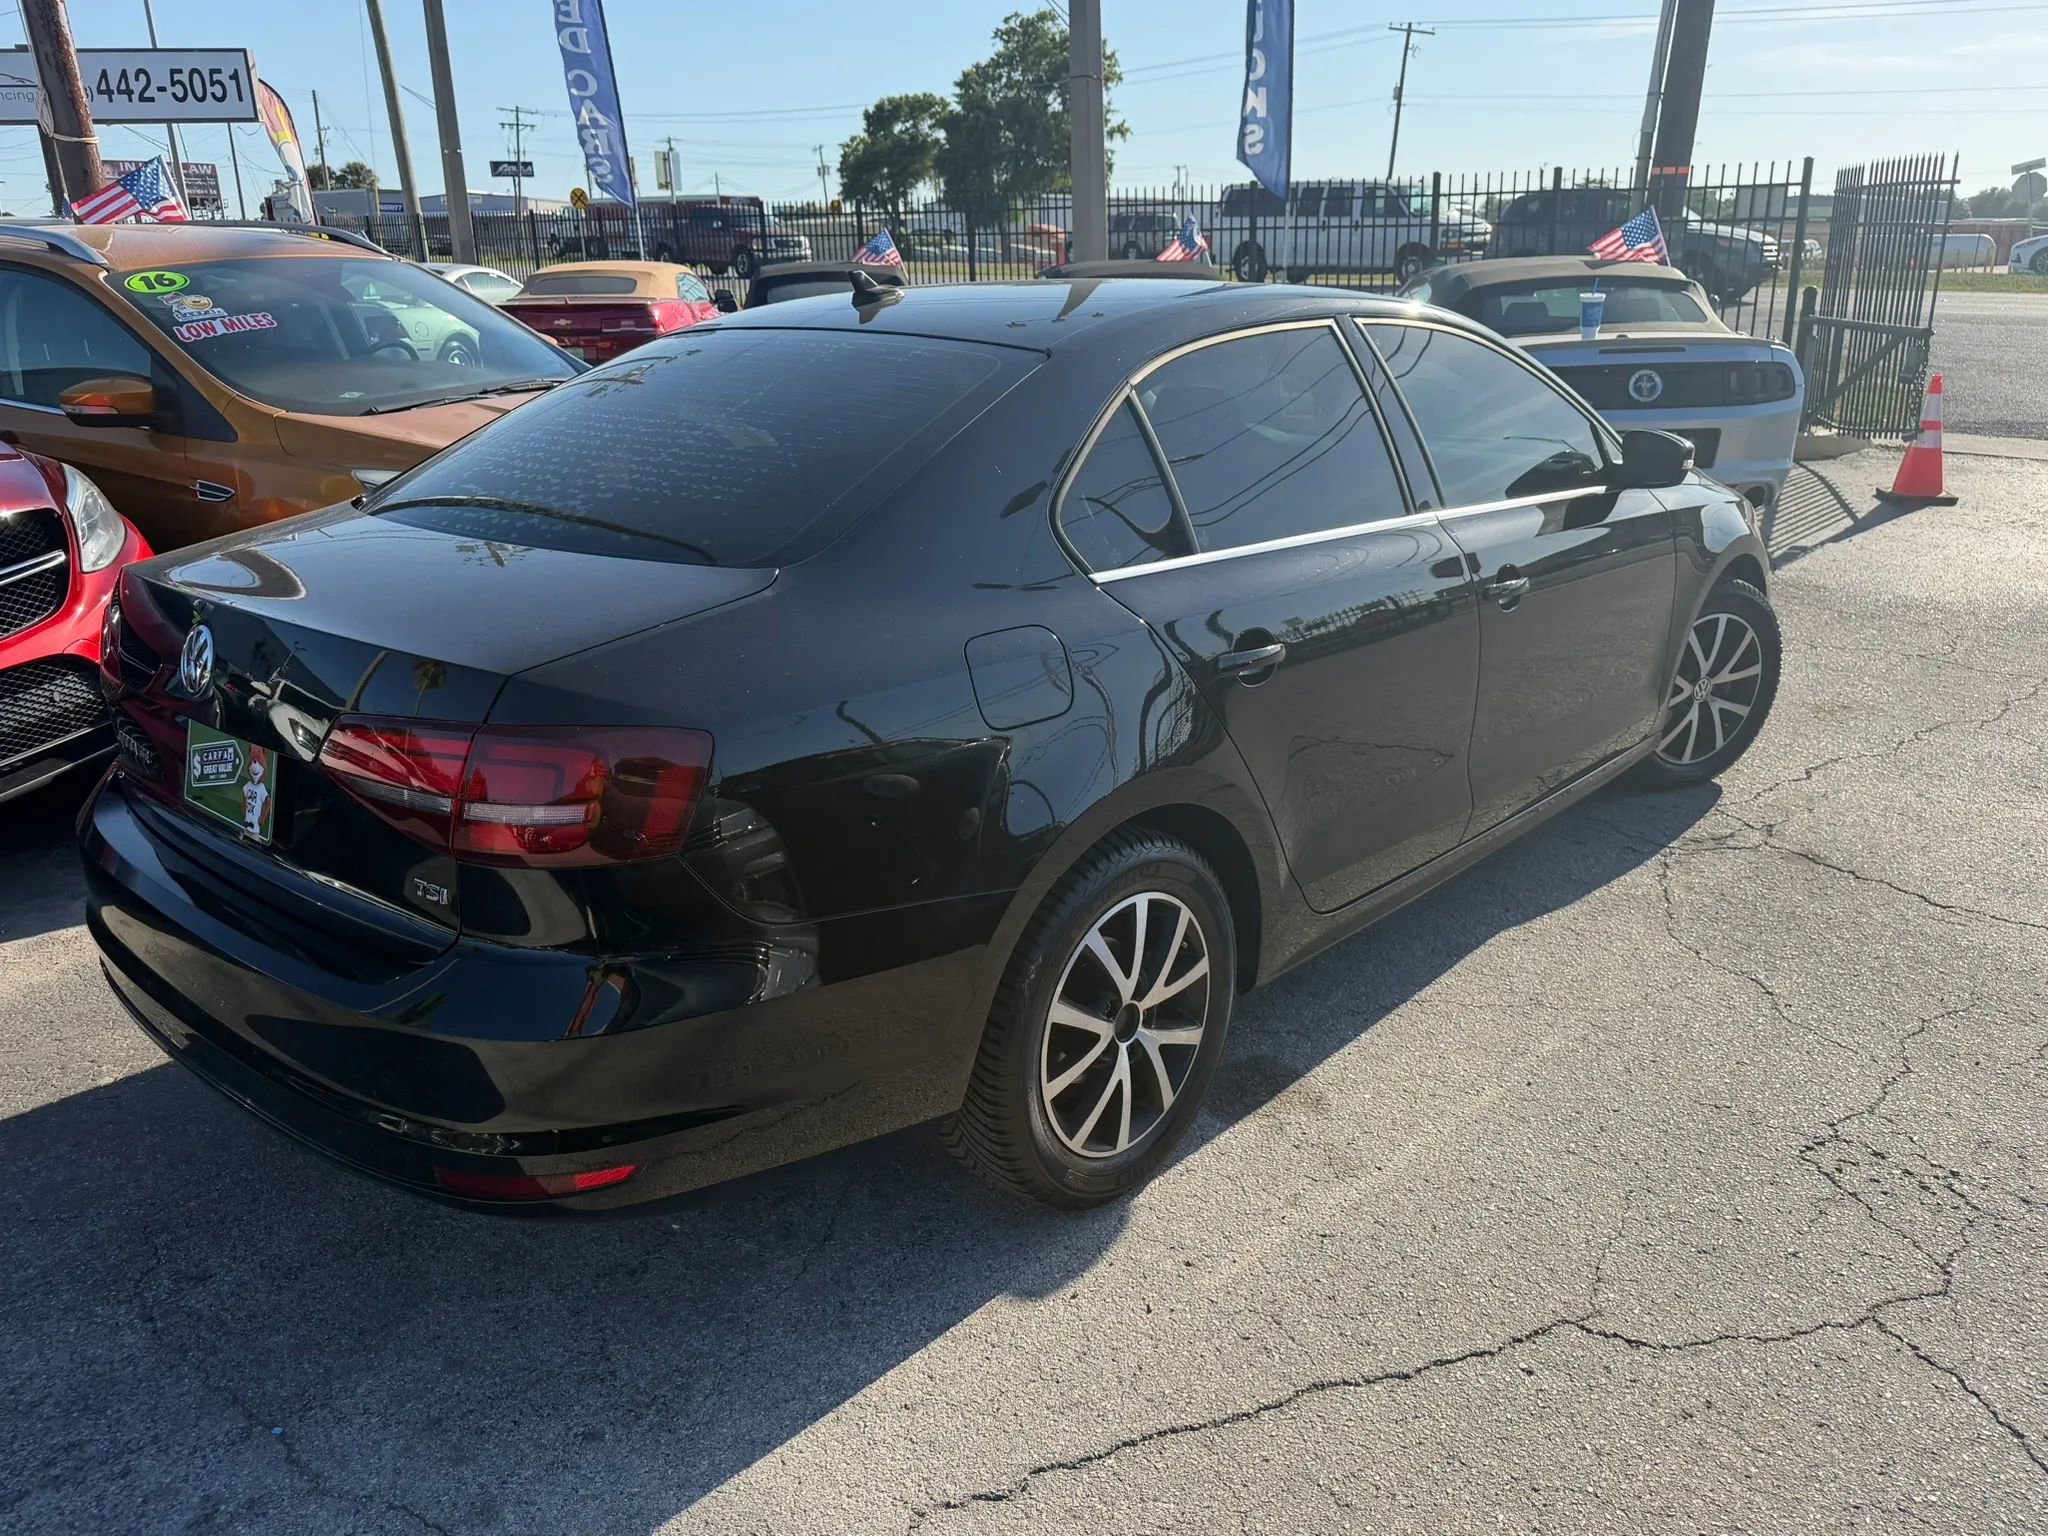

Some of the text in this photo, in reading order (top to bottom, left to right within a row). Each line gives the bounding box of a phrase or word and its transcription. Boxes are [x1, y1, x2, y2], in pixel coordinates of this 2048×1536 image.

[96, 68, 244, 104] 442-5051
[139, 273, 178, 290] 16
[175, 313, 276, 341] LOW MILES
[203, 747, 234, 762] CARFAX
[203, 762, 233, 775] GREAT VALUE
[414, 878, 448, 905] TSI
